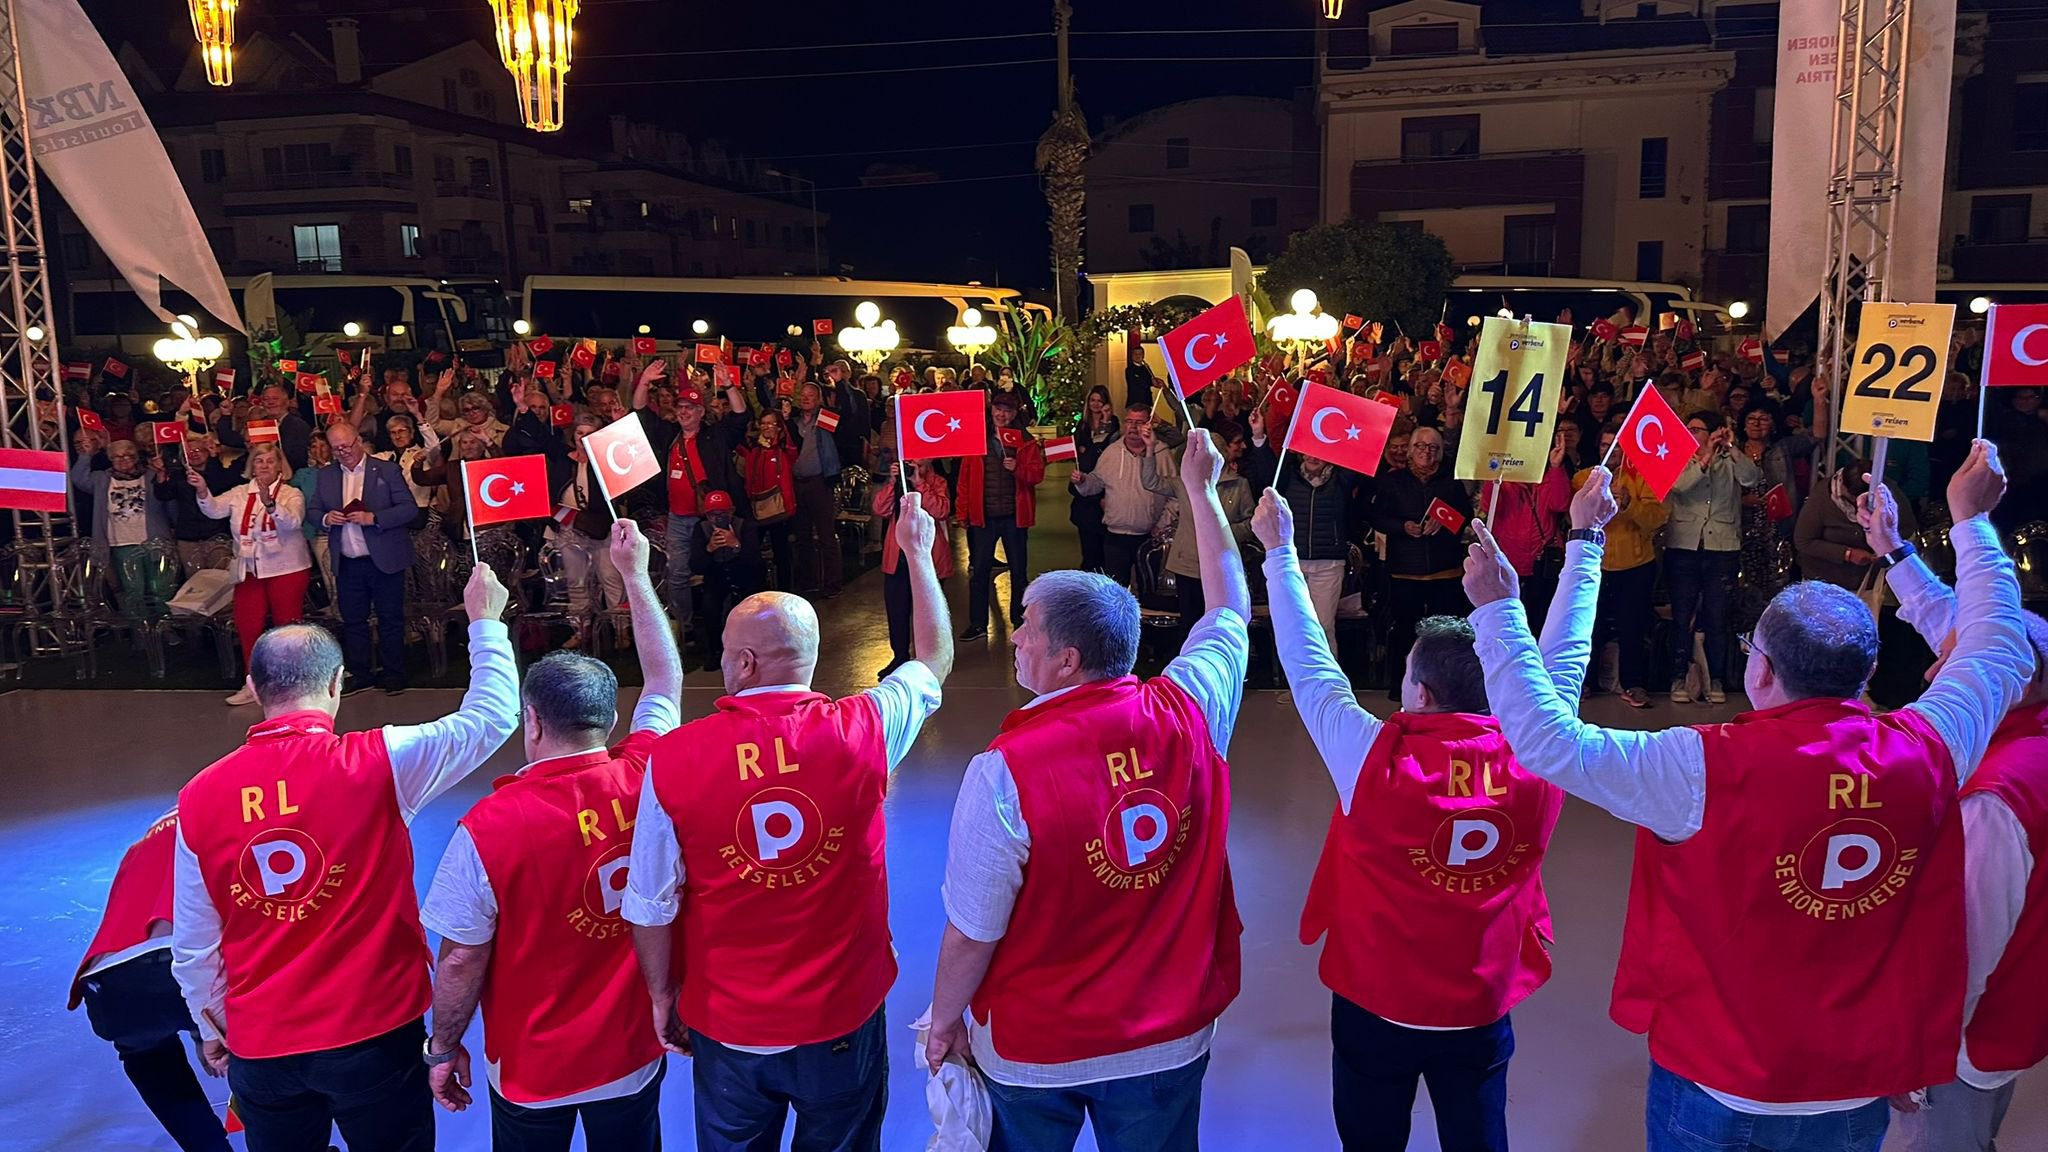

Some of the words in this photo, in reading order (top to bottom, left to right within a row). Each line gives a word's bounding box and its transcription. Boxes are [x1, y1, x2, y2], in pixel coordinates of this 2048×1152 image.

[1854, 343, 1937, 402] 22
[1482, 370, 1544, 437] 14
[1502, 457, 1524, 466] reisen
[719, 826, 845, 889] REISELEITER
[1085, 804, 1192, 890] SENIORENREISEN
[1408, 843, 1530, 894] REISELEITER
[229, 862, 347, 922] REISELEITER
[1775, 848, 1918, 920] SENIORENREISEN
